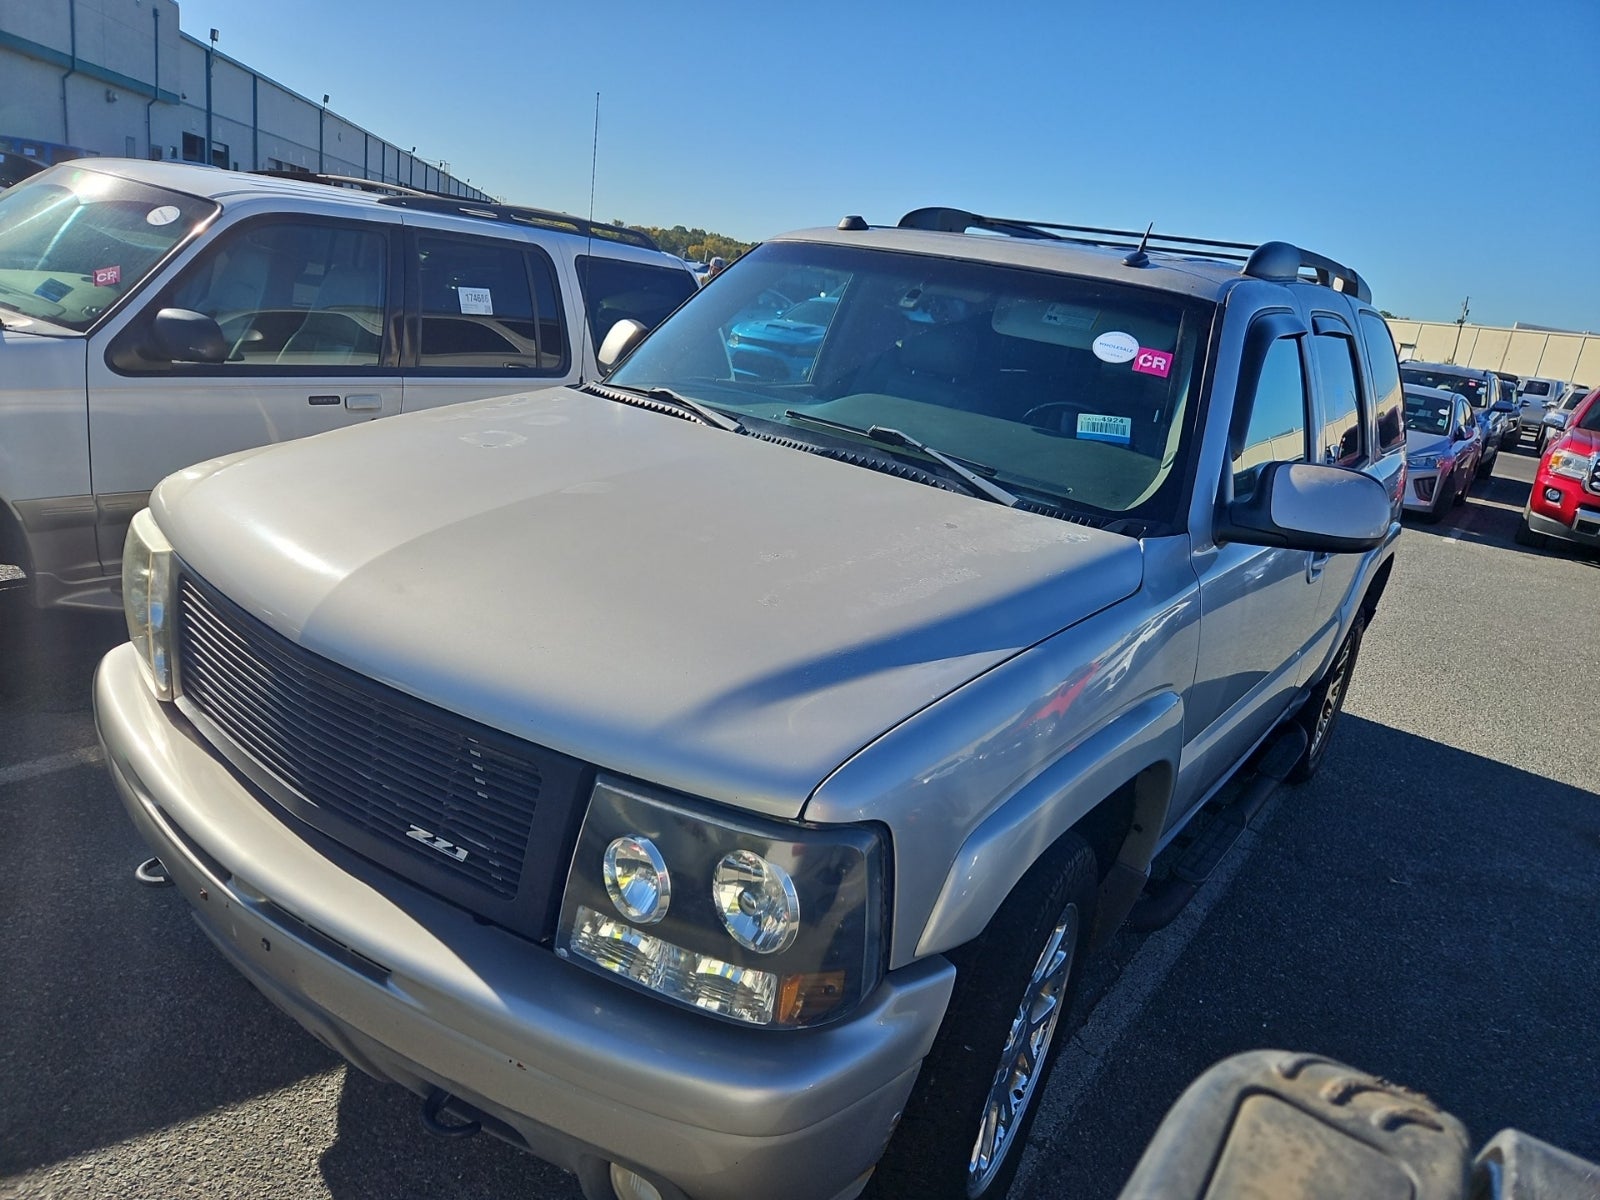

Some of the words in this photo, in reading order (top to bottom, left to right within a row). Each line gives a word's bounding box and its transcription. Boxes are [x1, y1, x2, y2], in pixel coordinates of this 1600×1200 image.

[1099, 342, 1134, 353] WHOLESALE
[1138, 354, 1167, 371] CR
[1101, 416, 1124, 424] 4924
